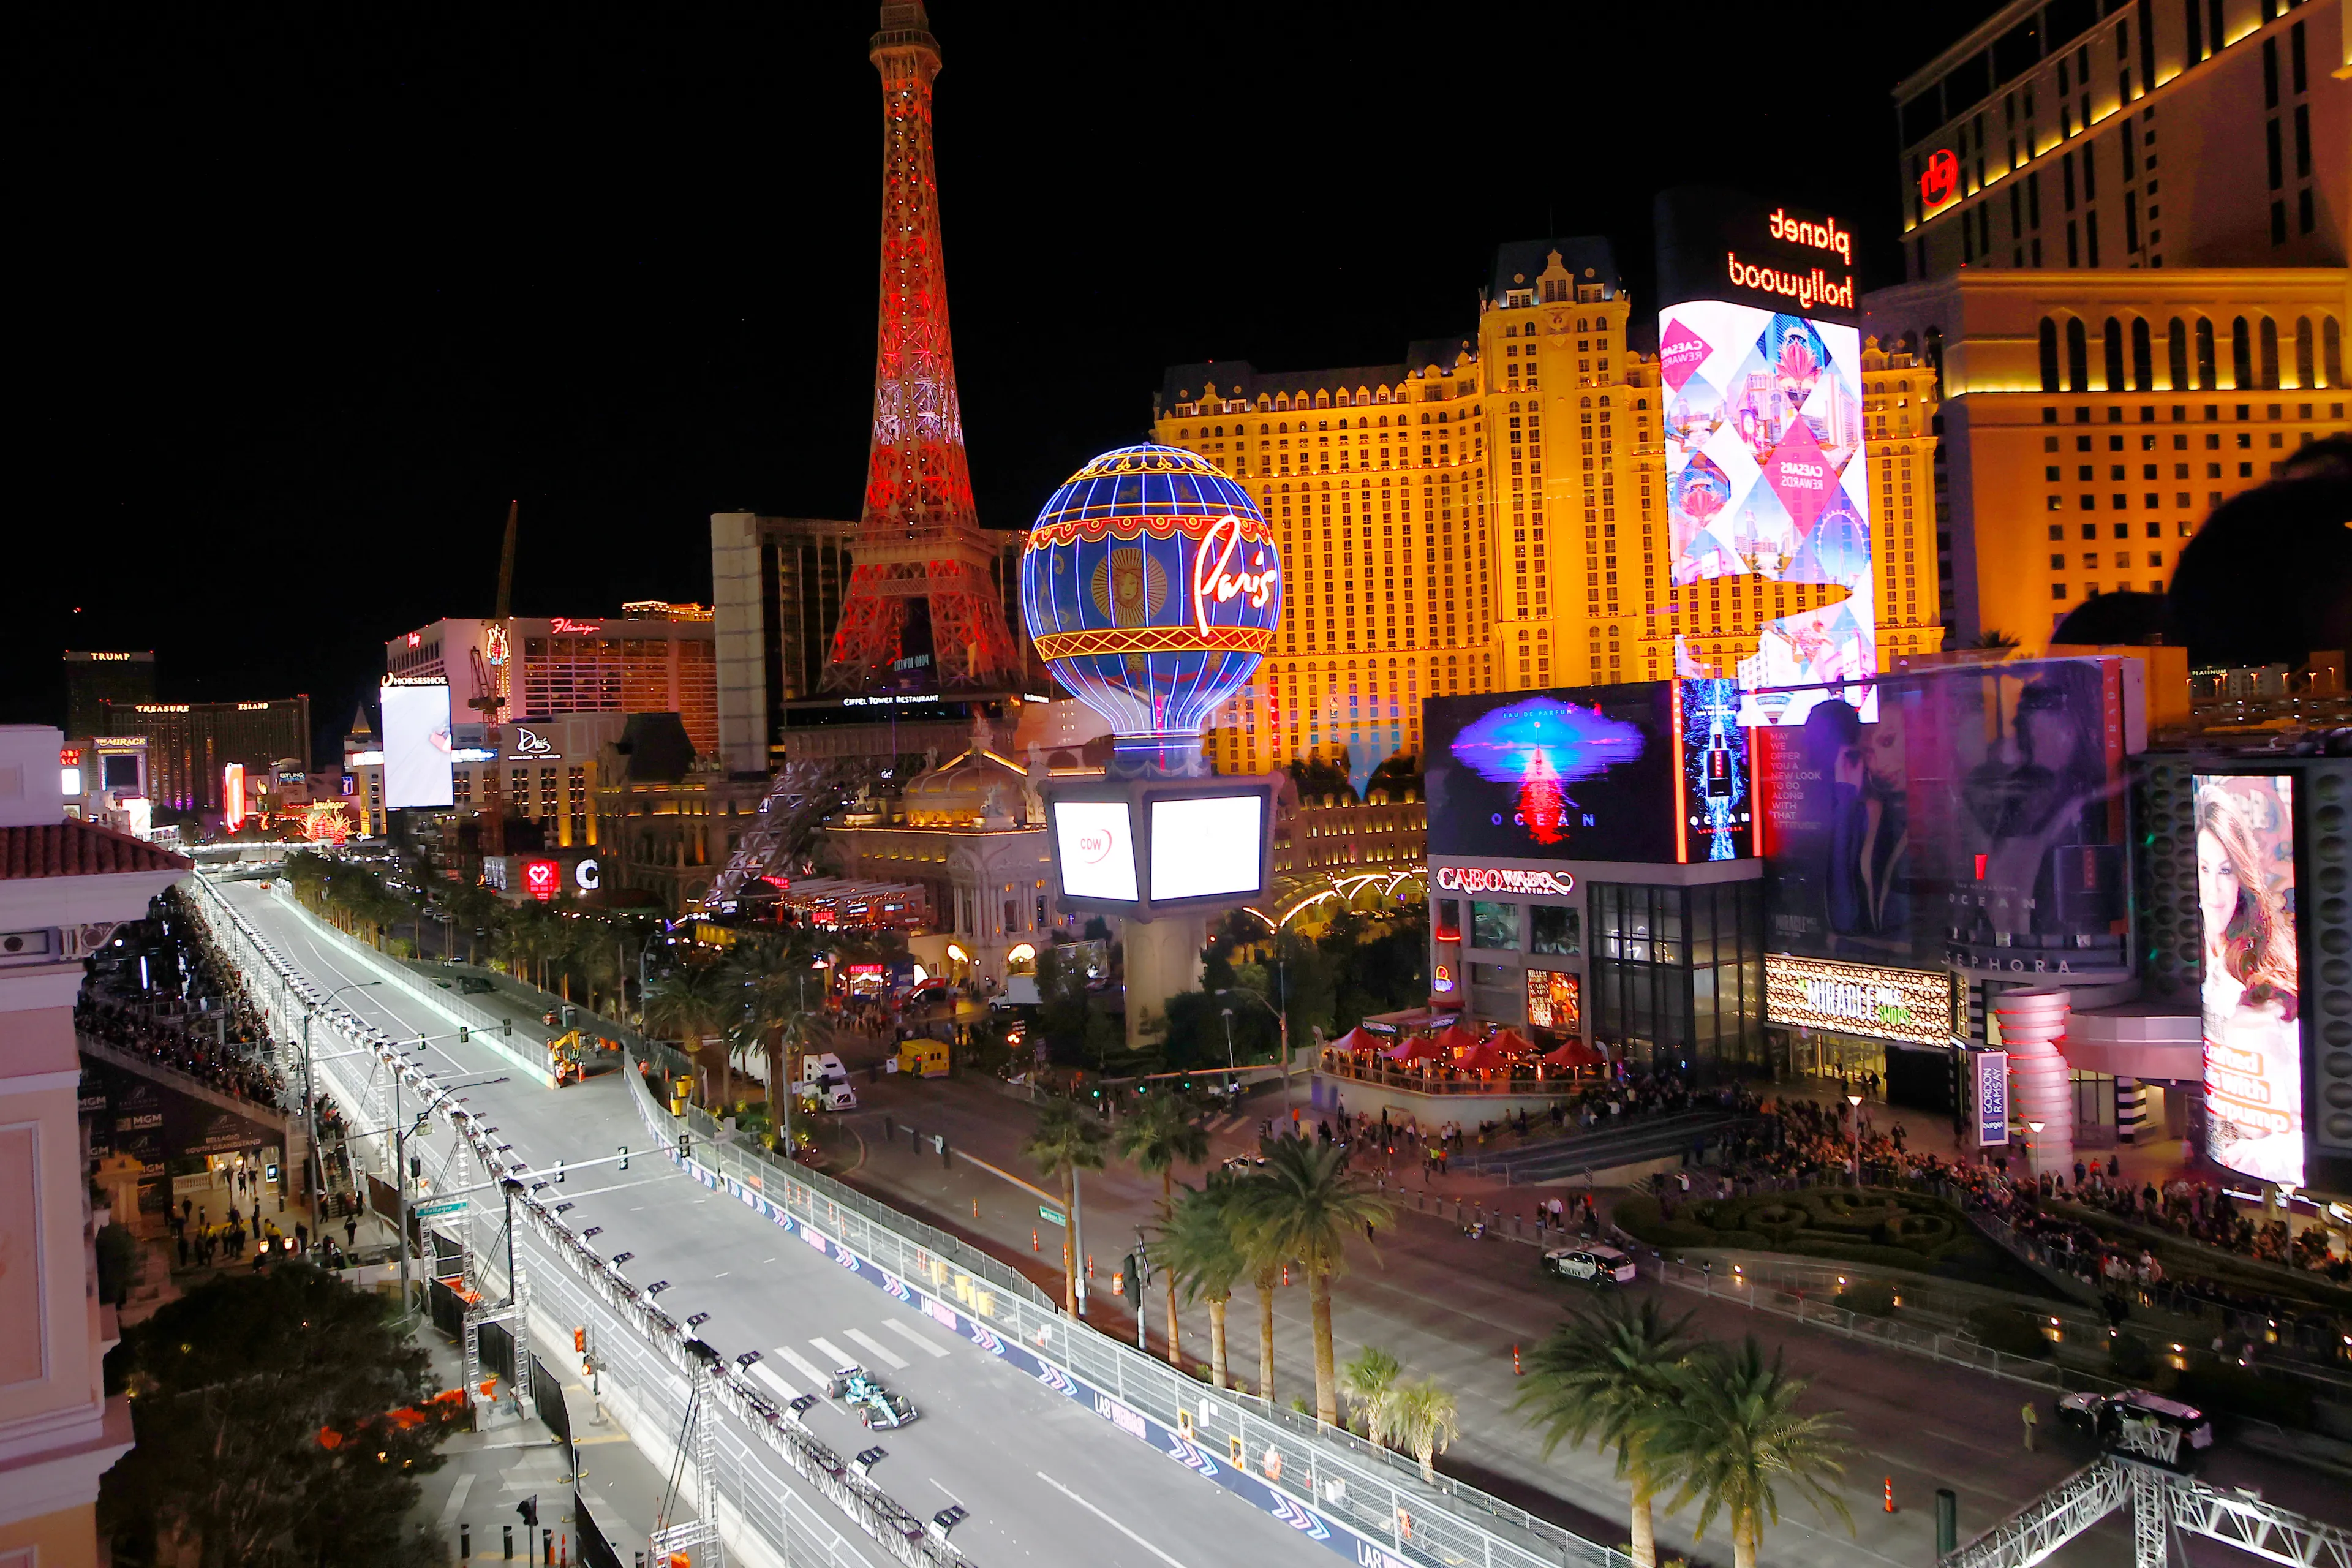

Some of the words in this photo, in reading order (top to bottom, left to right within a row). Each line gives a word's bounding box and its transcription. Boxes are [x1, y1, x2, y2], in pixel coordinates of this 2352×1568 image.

[1194, 514, 1278, 637] Paris
[551, 617, 600, 635] Flamingo
[393, 676, 448, 685] HORSESHOE
[896, 695, 940, 703] RESTAURANT
[1491, 813, 1595, 827] OCEAN
[1690, 813, 1749, 826] OCEAN
[1080, 837, 1101, 850] CDW
[1436, 867, 1503, 894] CABO
[1501, 870, 1557, 888] WABO
[1506, 886, 1551, 895] CANTINA
[1941, 951, 2073, 973] SEPHORA
[1806, 980, 1877, 1022] MIRACLE
[1875, 986, 1902, 1006] MILE
[1877, 1005, 1911, 1026] SHOPS
[1982, 1068, 1993, 1114] GORDON
[1992, 1068, 2003, 1113] RAMSAY
[133, 1114, 162, 1125] MGM
[1983, 1121, 2004, 1130] burger
[185, 1145, 211, 1155] SOUTH
[212, 1139, 262, 1151] GRANDSTAND
[1094, 1392, 1112, 1420] LAS
